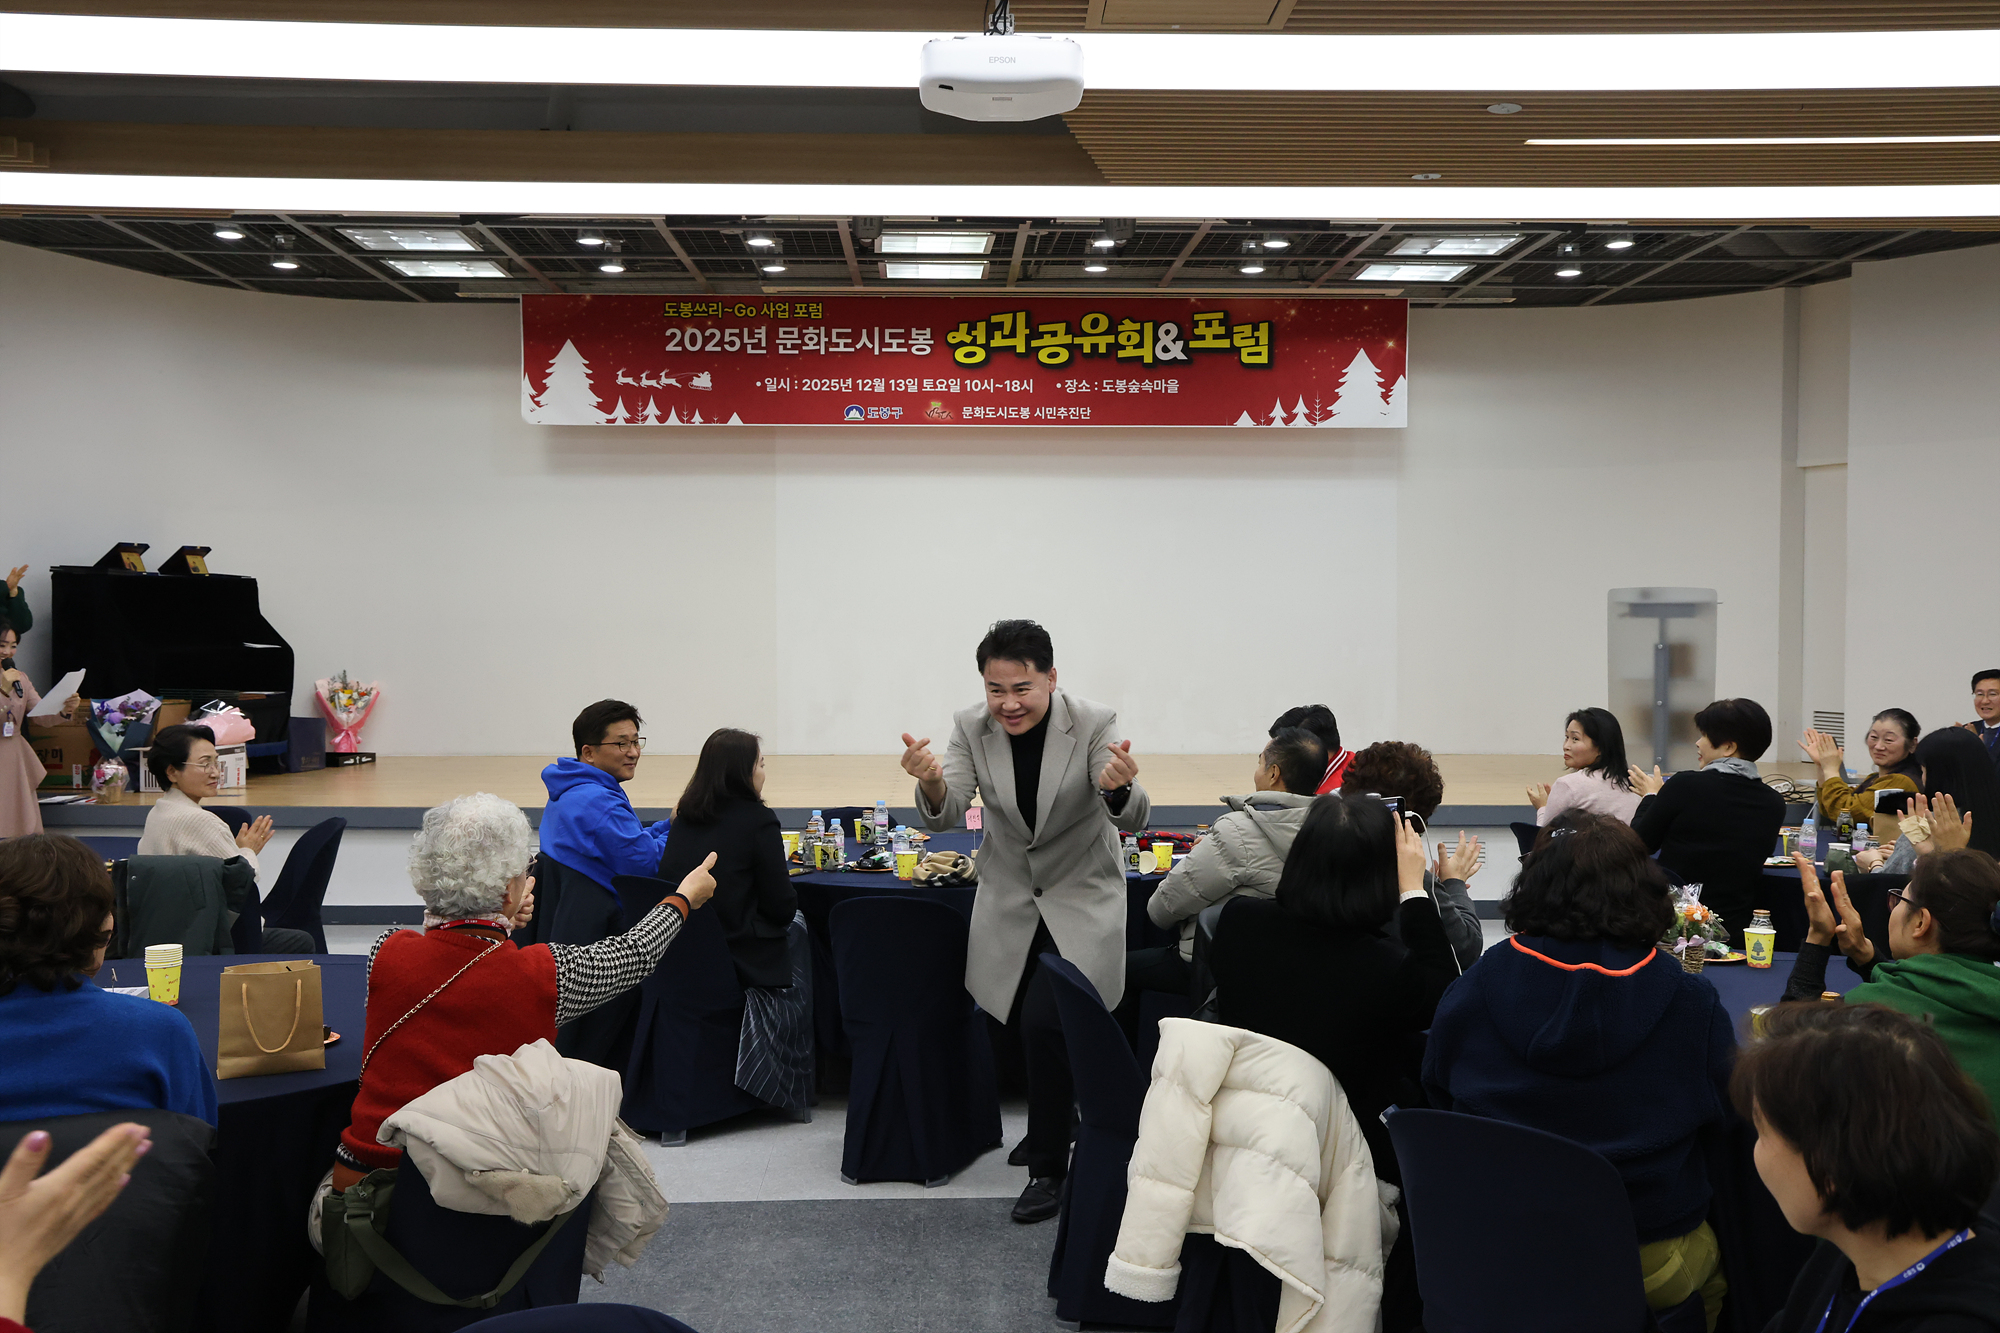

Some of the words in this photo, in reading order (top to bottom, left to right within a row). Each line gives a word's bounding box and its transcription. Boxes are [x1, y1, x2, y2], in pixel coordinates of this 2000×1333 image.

[988, 56, 1016, 64] EPSON
[664, 302, 756, 318] 도봉쓰리~Go
[760, 302, 789, 318] 사업
[793, 302, 823, 318] 포럼
[665, 325, 767, 354] 2025년
[775, 326, 935, 356] 문화도시도봉
[946, 311, 1271, 366] 성과공유회&포럼
[764, 377, 790, 392] 일시
[801, 377, 853, 392] 2025년
[856, 377, 885, 393] 12월
[888, 378, 919, 393] 13일
[921, 378, 961, 393] 토요일
[964, 378, 1034, 394] 10시~18시
[1064, 379, 1091, 394] 장소
[1101, 379, 1180, 394] 도봉숲속마을
[866, 406, 904, 420] 도봉구
[961, 406, 1031, 420] 문화도시도봉
[1033, 406, 1092, 420] 시민추진단
